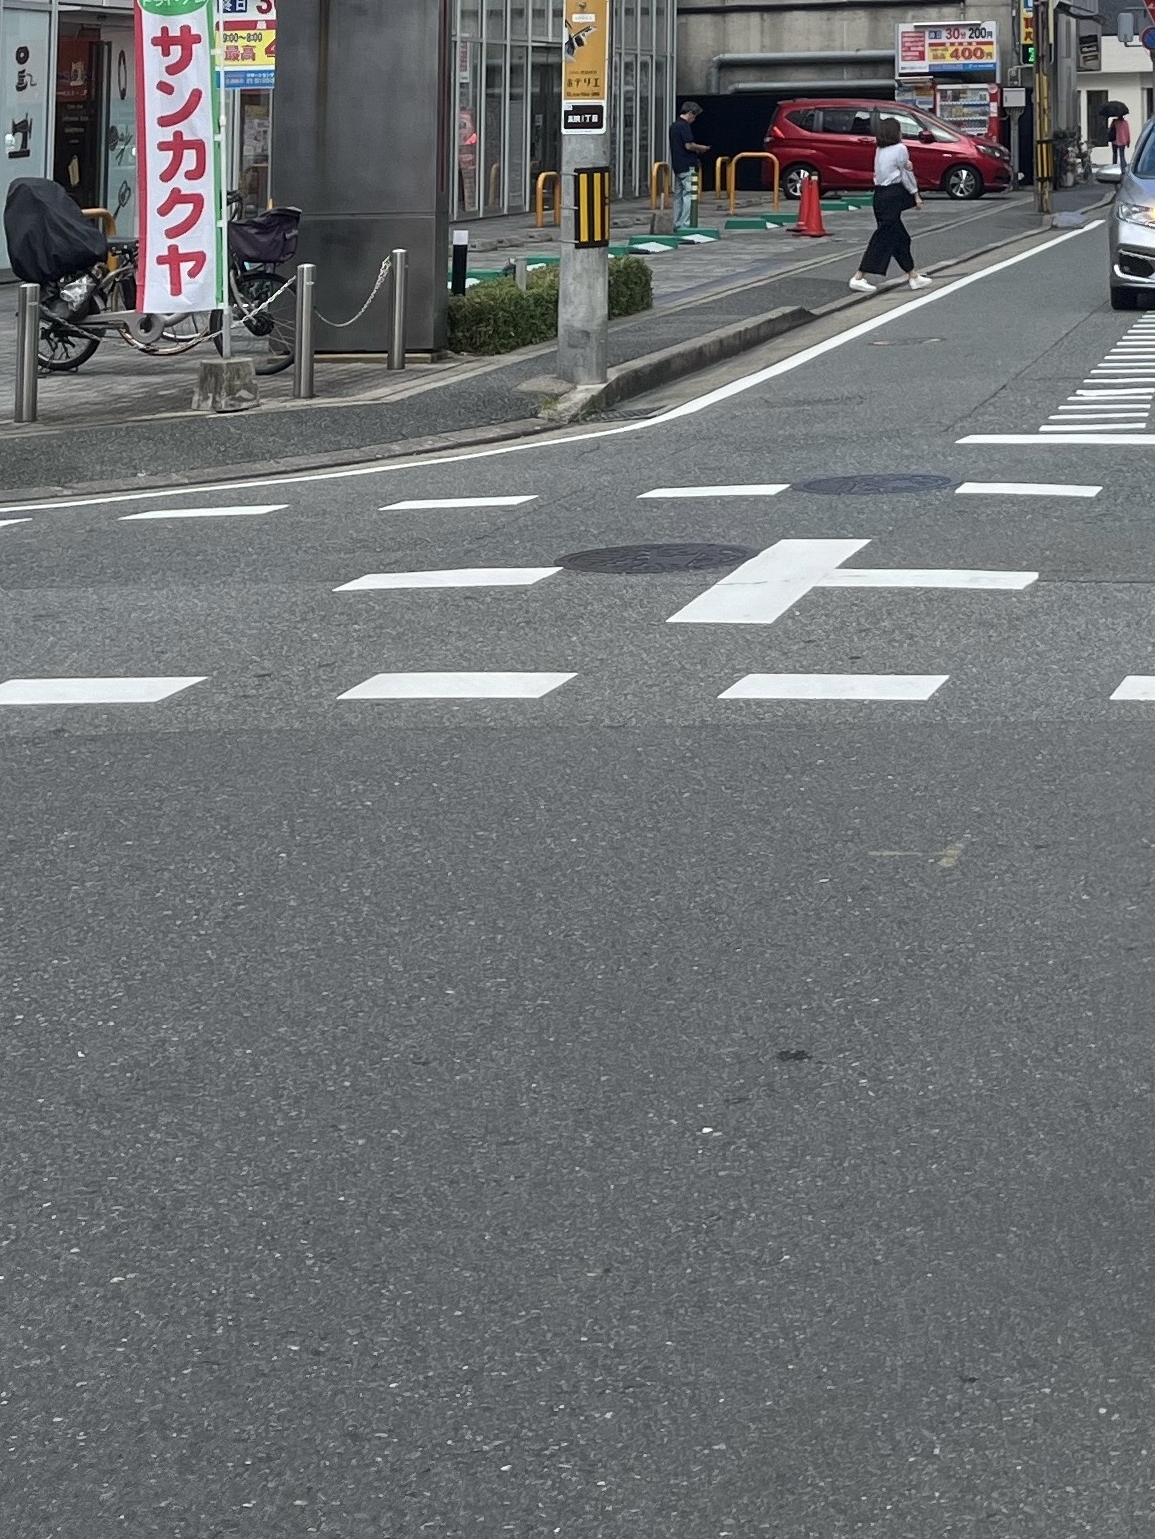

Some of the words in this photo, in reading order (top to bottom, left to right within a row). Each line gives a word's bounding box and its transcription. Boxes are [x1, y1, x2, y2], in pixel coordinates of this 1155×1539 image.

[968, 27, 992, 39] 200円
[150, 24, 207, 297] サンカクヤ
